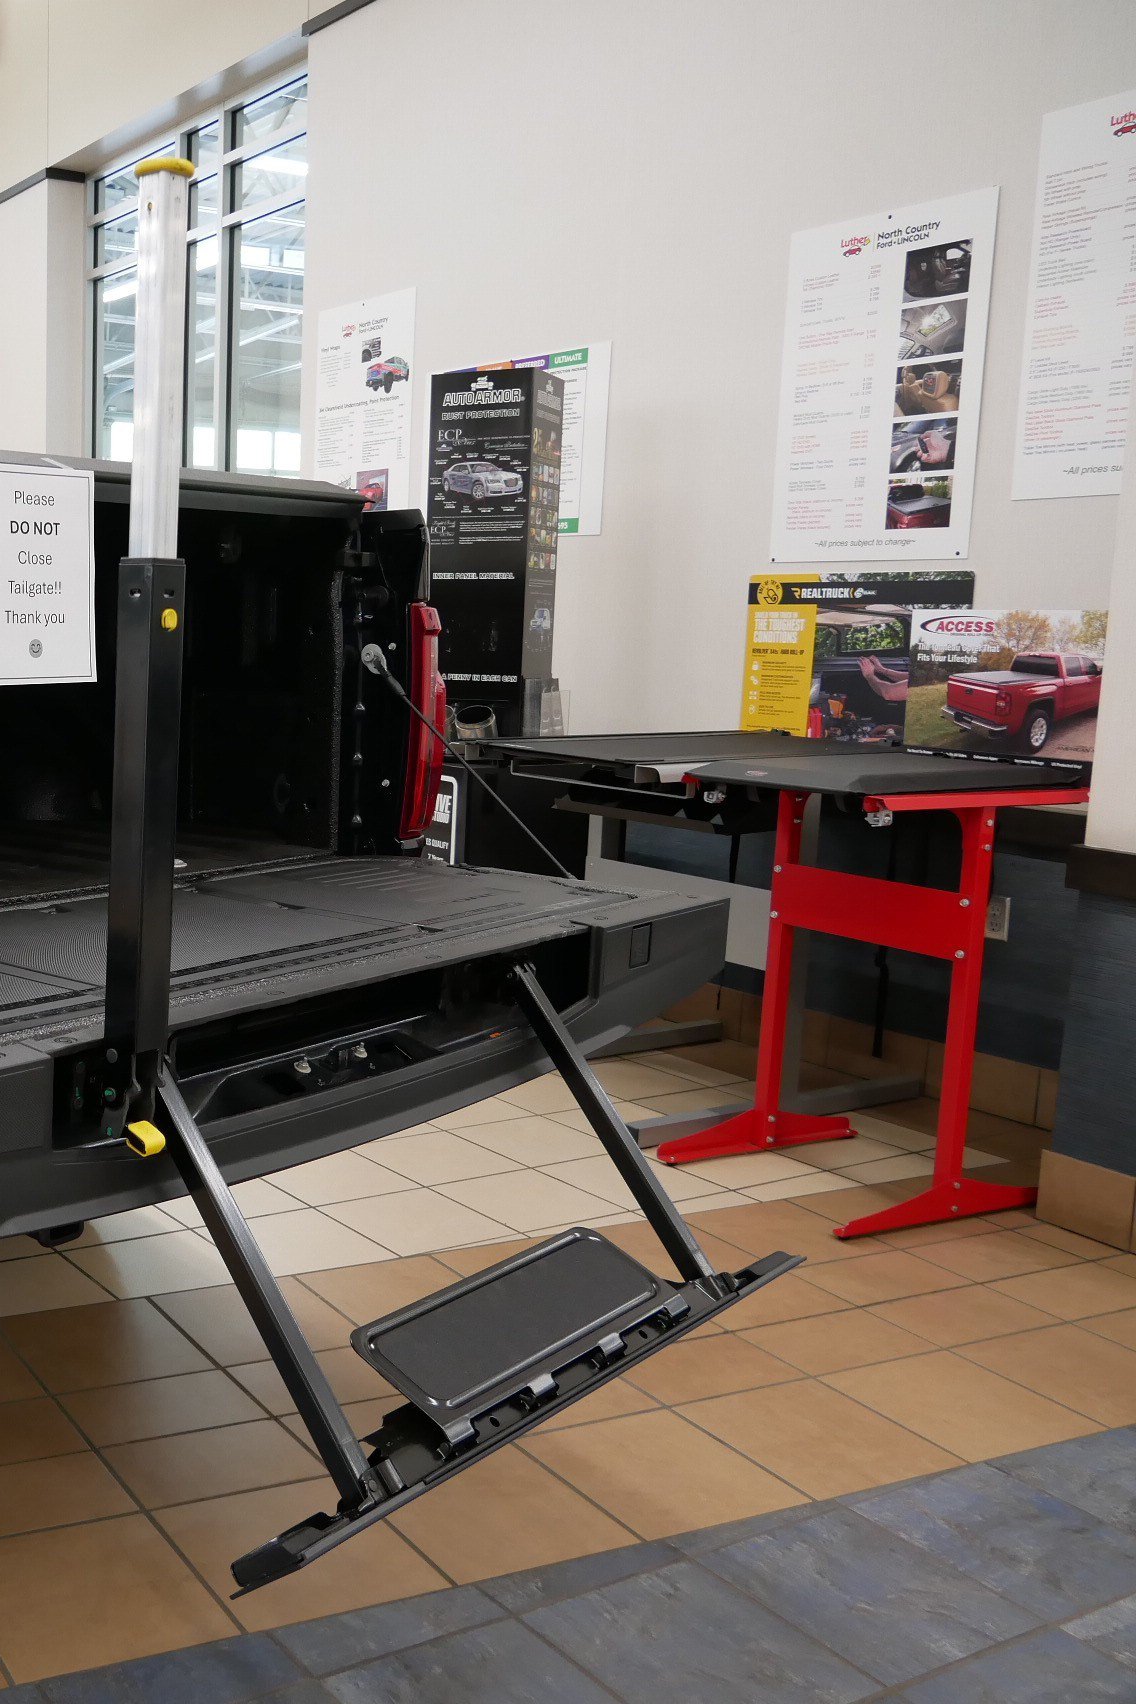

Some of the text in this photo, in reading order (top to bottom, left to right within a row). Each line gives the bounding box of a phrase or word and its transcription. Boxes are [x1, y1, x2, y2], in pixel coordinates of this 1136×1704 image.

[878, 221, 940, 240] North Country
[554, 353, 582, 364] ULTIMATE
[442, 389, 521, 406] AUTOARMOR
[442, 409, 520, 420] RUST PROTECTION
[1081, 465, 1108, 475] prices
[14, 490, 55, 506] Please
[10, 521, 60, 535] DO NOT
[828, 540, 848, 548] prices
[850, 539, 874, 547] subject
[18, 551, 52, 565] Close
[8, 580, 62, 598] Tailgate!!
[801, 588, 850, 599] REALTRUCK
[5, 610, 65, 627] Thank you
[936, 621, 995, 632] ACCESS
[983, 644, 1000, 652] That
[917, 654, 977, 664] Fits Your Lifestyle
